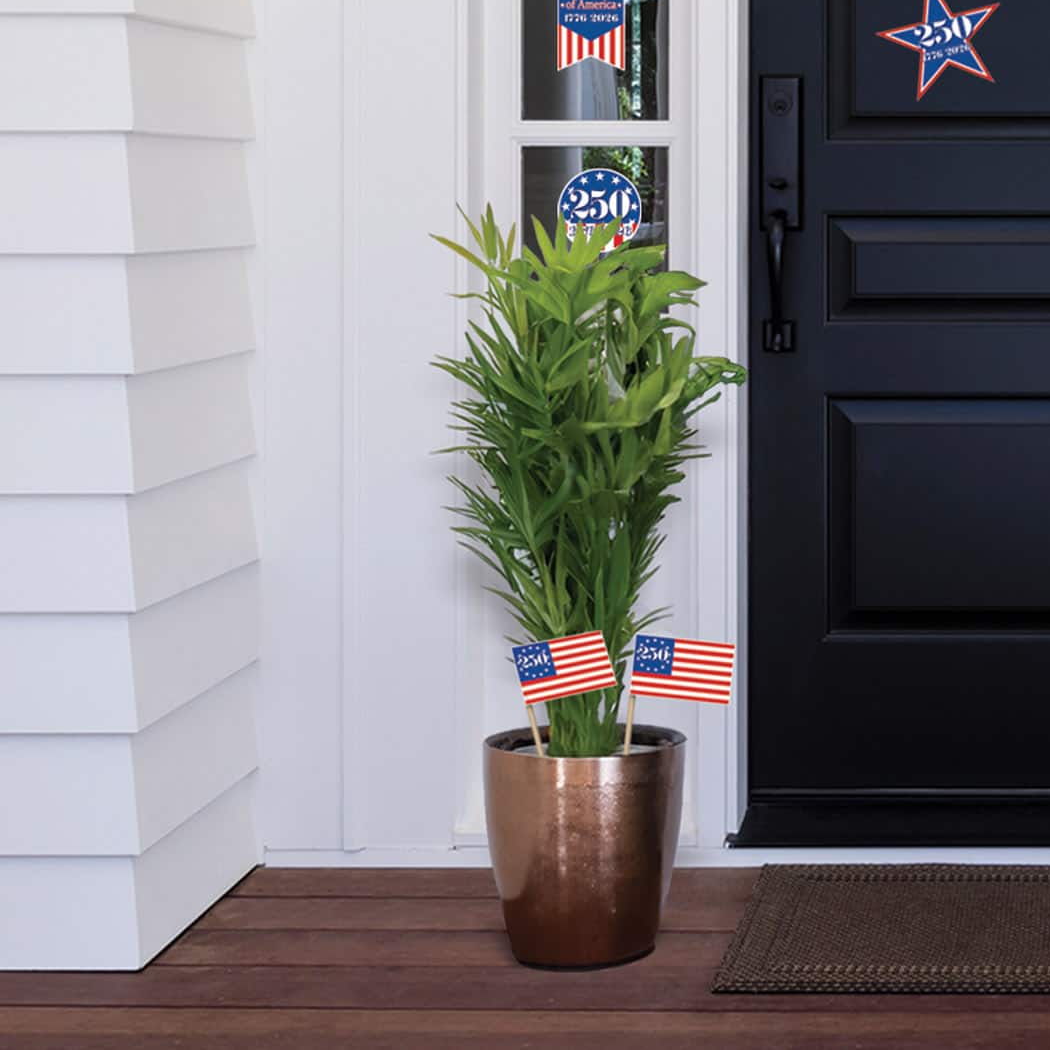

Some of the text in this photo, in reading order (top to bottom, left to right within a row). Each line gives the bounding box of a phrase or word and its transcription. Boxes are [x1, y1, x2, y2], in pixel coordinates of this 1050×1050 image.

[914, 15, 972, 47] 250
[568, 189, 631, 220] 250
[519, 653, 548, 668] 250
[640, 644, 669, 660] 250
